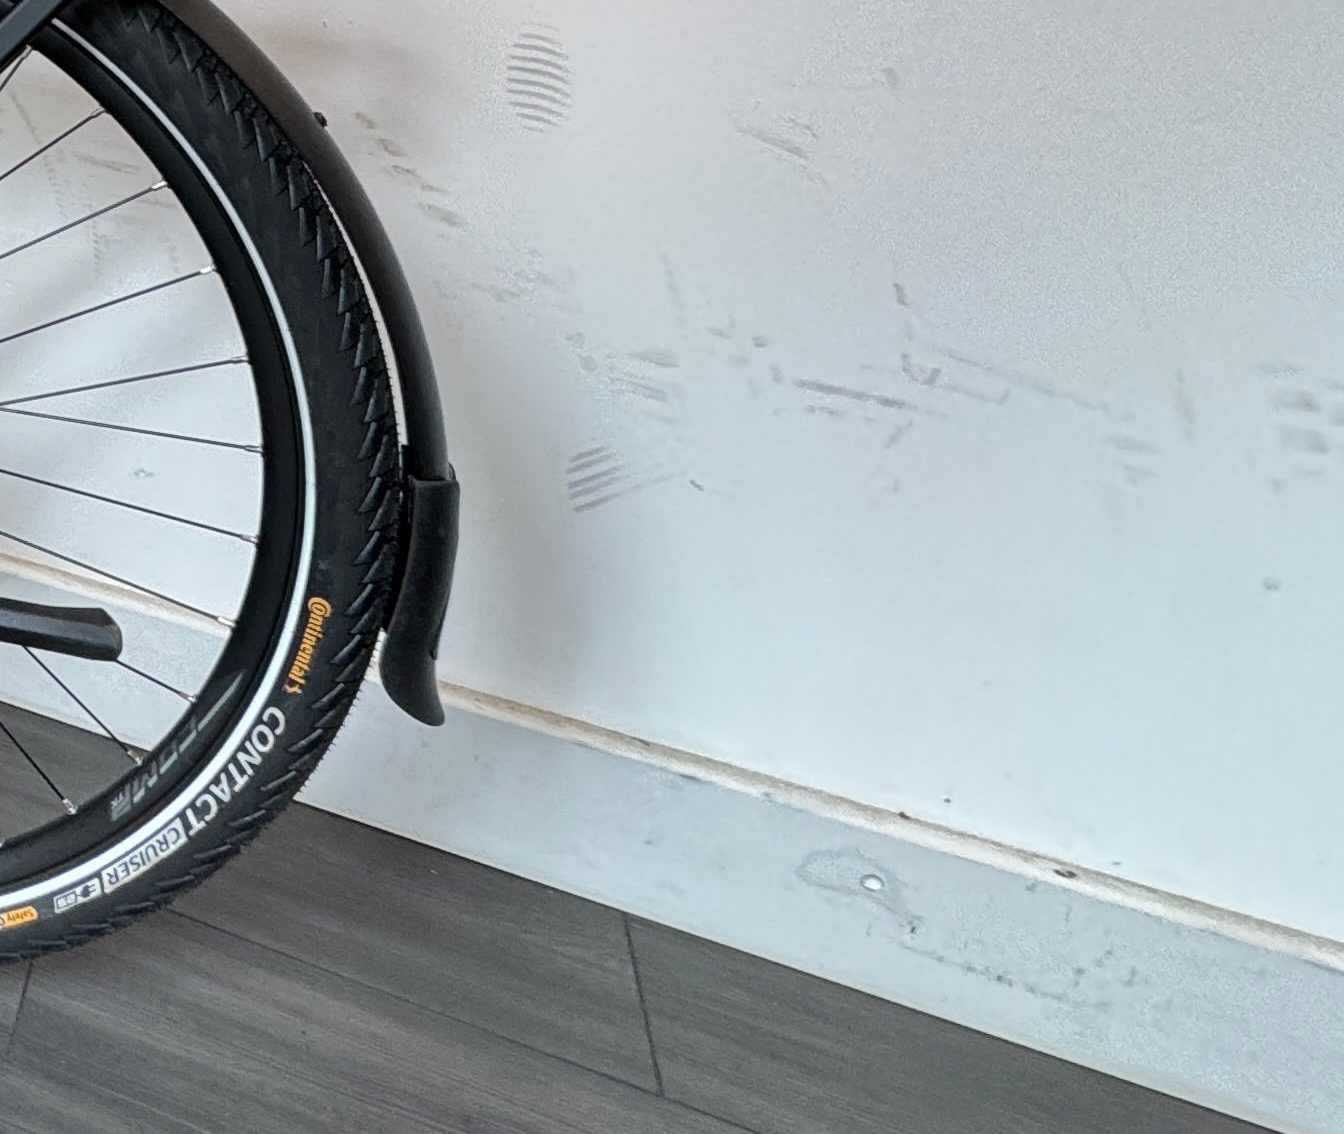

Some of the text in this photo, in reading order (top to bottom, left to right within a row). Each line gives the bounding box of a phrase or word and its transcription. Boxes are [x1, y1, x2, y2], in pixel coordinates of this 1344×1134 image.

[288, 596, 333, 685] Continental
[106, 706, 286, 886] CONTACT CRUISER
